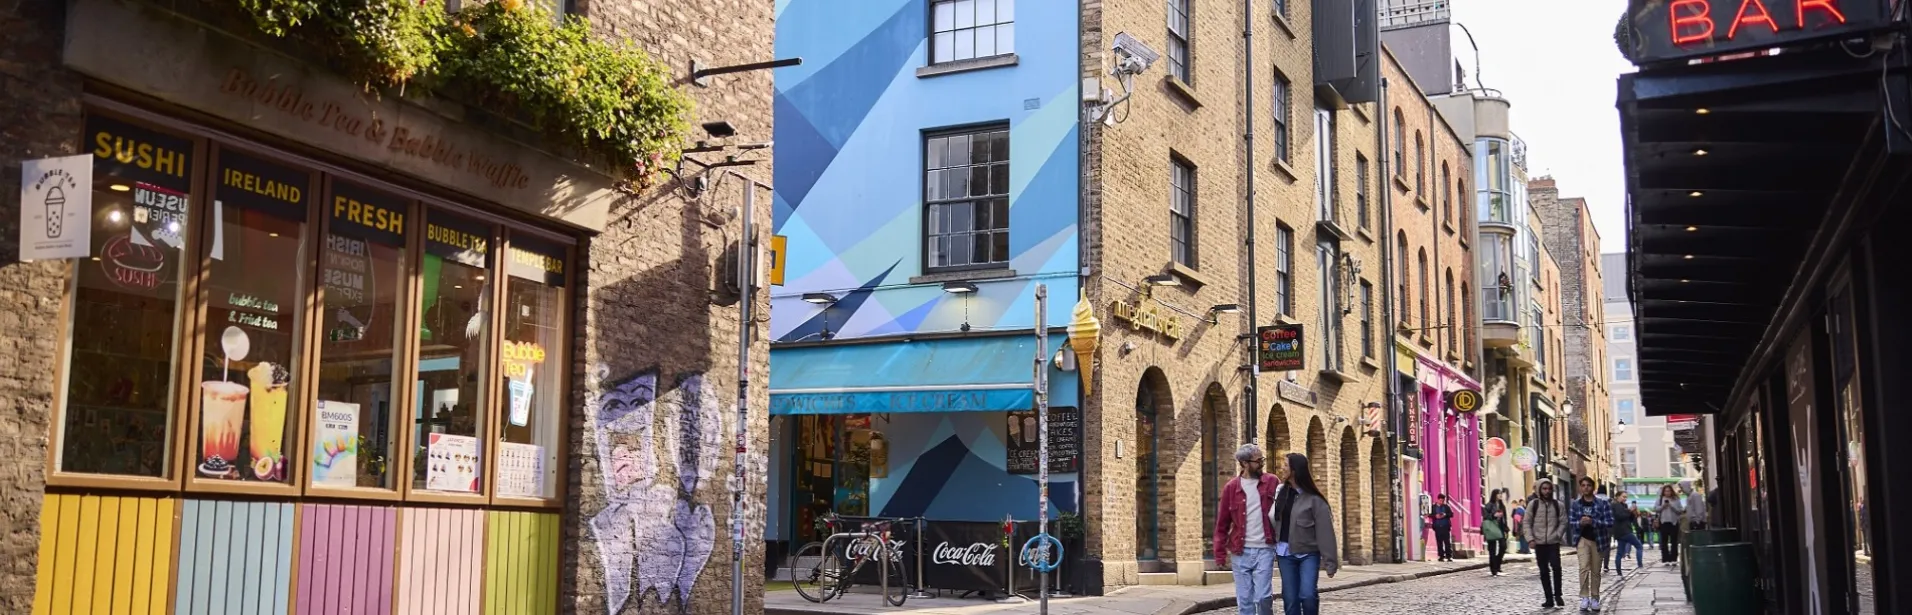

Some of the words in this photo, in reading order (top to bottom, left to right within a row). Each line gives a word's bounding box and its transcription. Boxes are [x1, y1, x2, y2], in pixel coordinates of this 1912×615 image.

[1669, 0, 1845, 44] BAR
[95, 131, 186, 178] SUSHI
[317, 101, 361, 137] Tea
[365, 119, 387, 144] &
[467, 149, 531, 191] Waffle
[223, 167, 301, 204] IRELAND
[334, 195, 404, 235] FRESH
[427, 223, 468, 249] BUBBLE
[470, 235, 488, 254] TEA
[511, 246, 546, 270] TEMPLE
[546, 257, 563, 274] BAR
[228, 292, 262, 309] bubble
[263, 300, 278, 312] tea
[228, 310, 236, 322] &
[262, 316, 278, 330] tea
[1262, 329, 1297, 340] Coffee
[1270, 342, 1291, 351] Cake
[503, 340, 545, 361] Bubble
[503, 360, 525, 376] Tea
[321, 411, 353, 422] BM600S
[1407, 394, 1418, 443] VINTAGE
[932, 541, 999, 567] Coca-Cola
